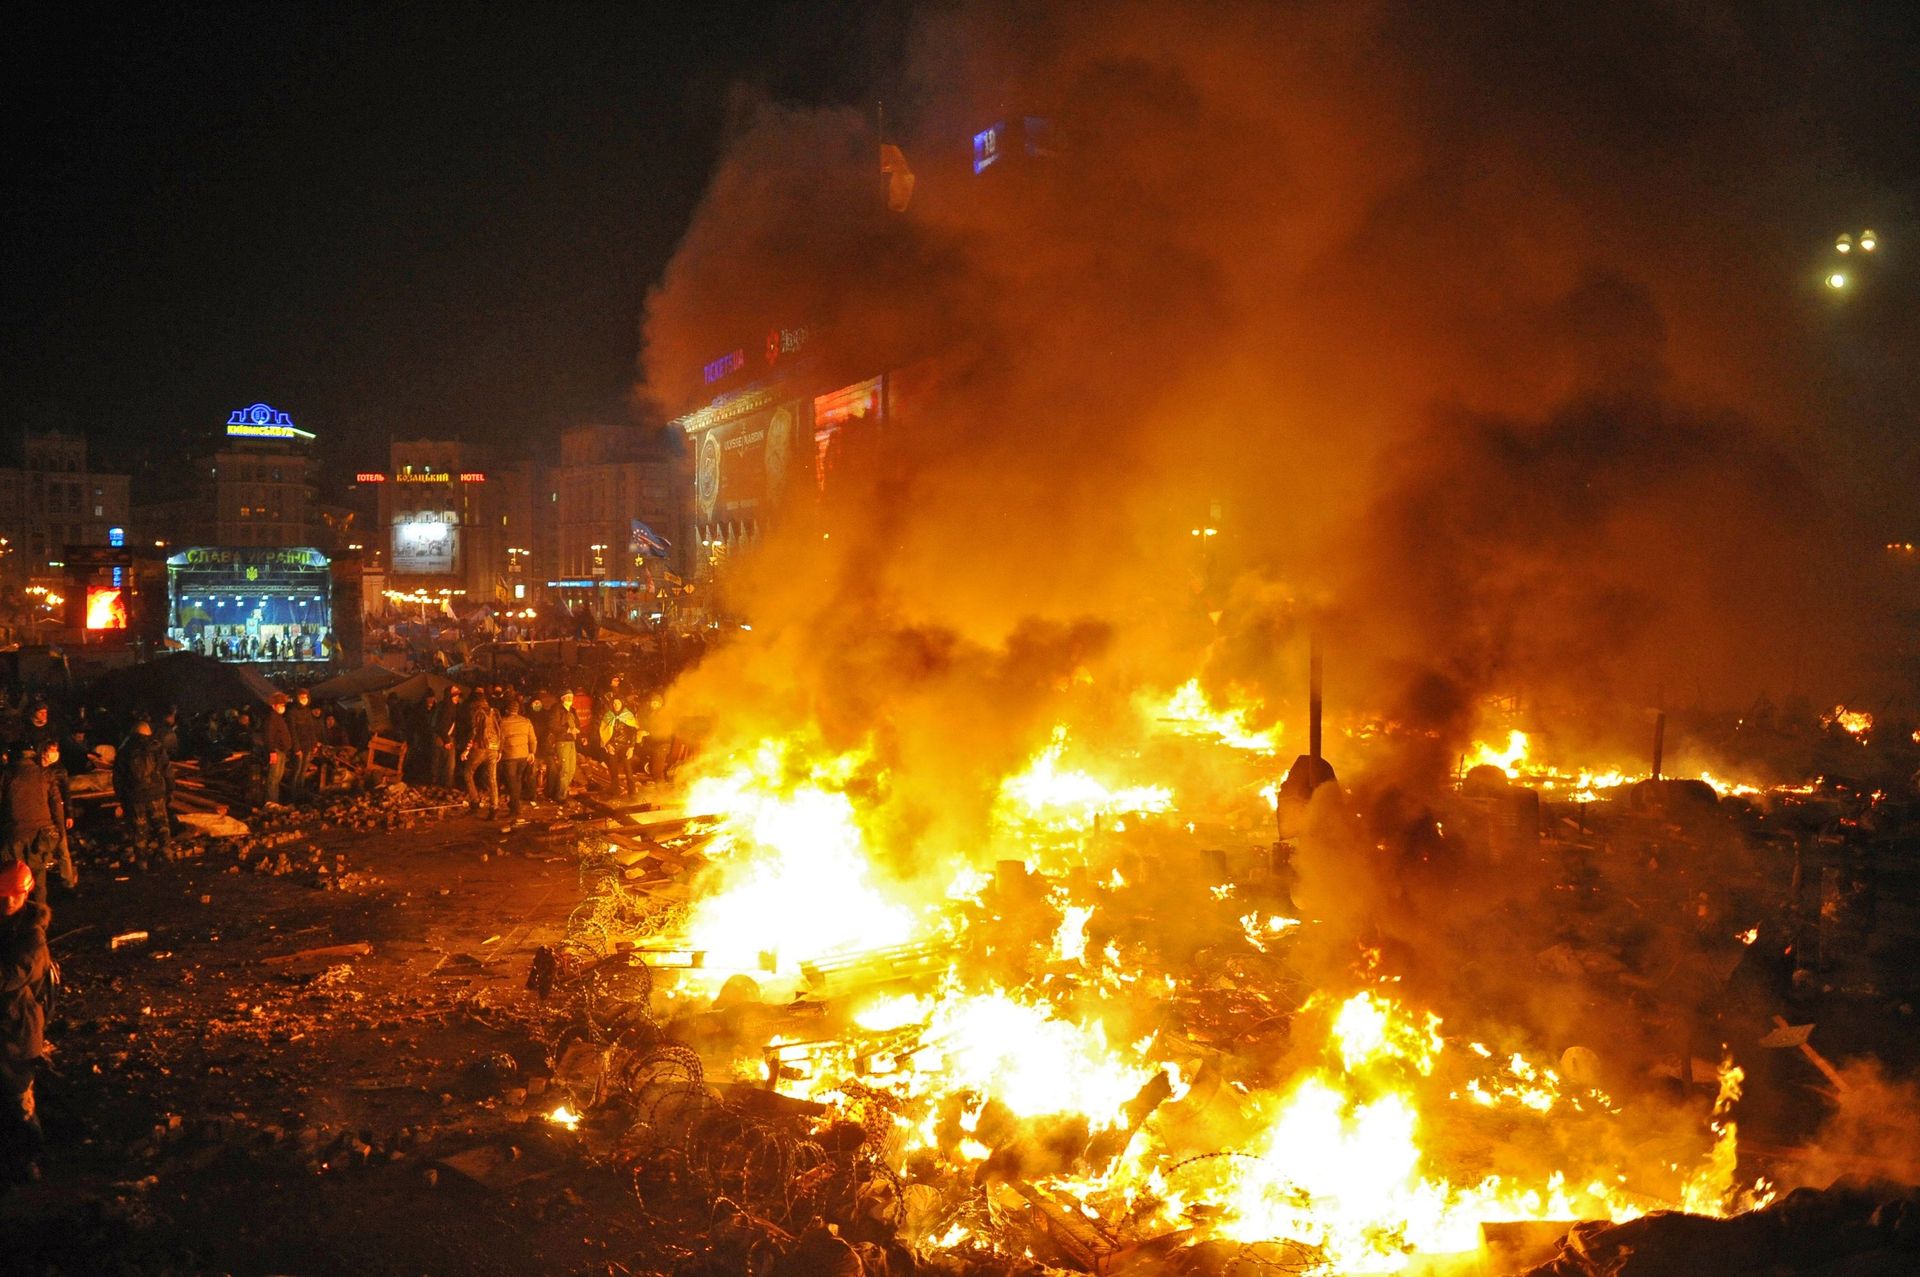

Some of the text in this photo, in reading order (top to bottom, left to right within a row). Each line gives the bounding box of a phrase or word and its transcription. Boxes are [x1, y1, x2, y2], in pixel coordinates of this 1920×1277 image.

[356, 473, 385, 482] ГОТЕЛЬ
[461, 473, 485, 482] HOTEL
[187, 550, 241, 564] СЛАВА
